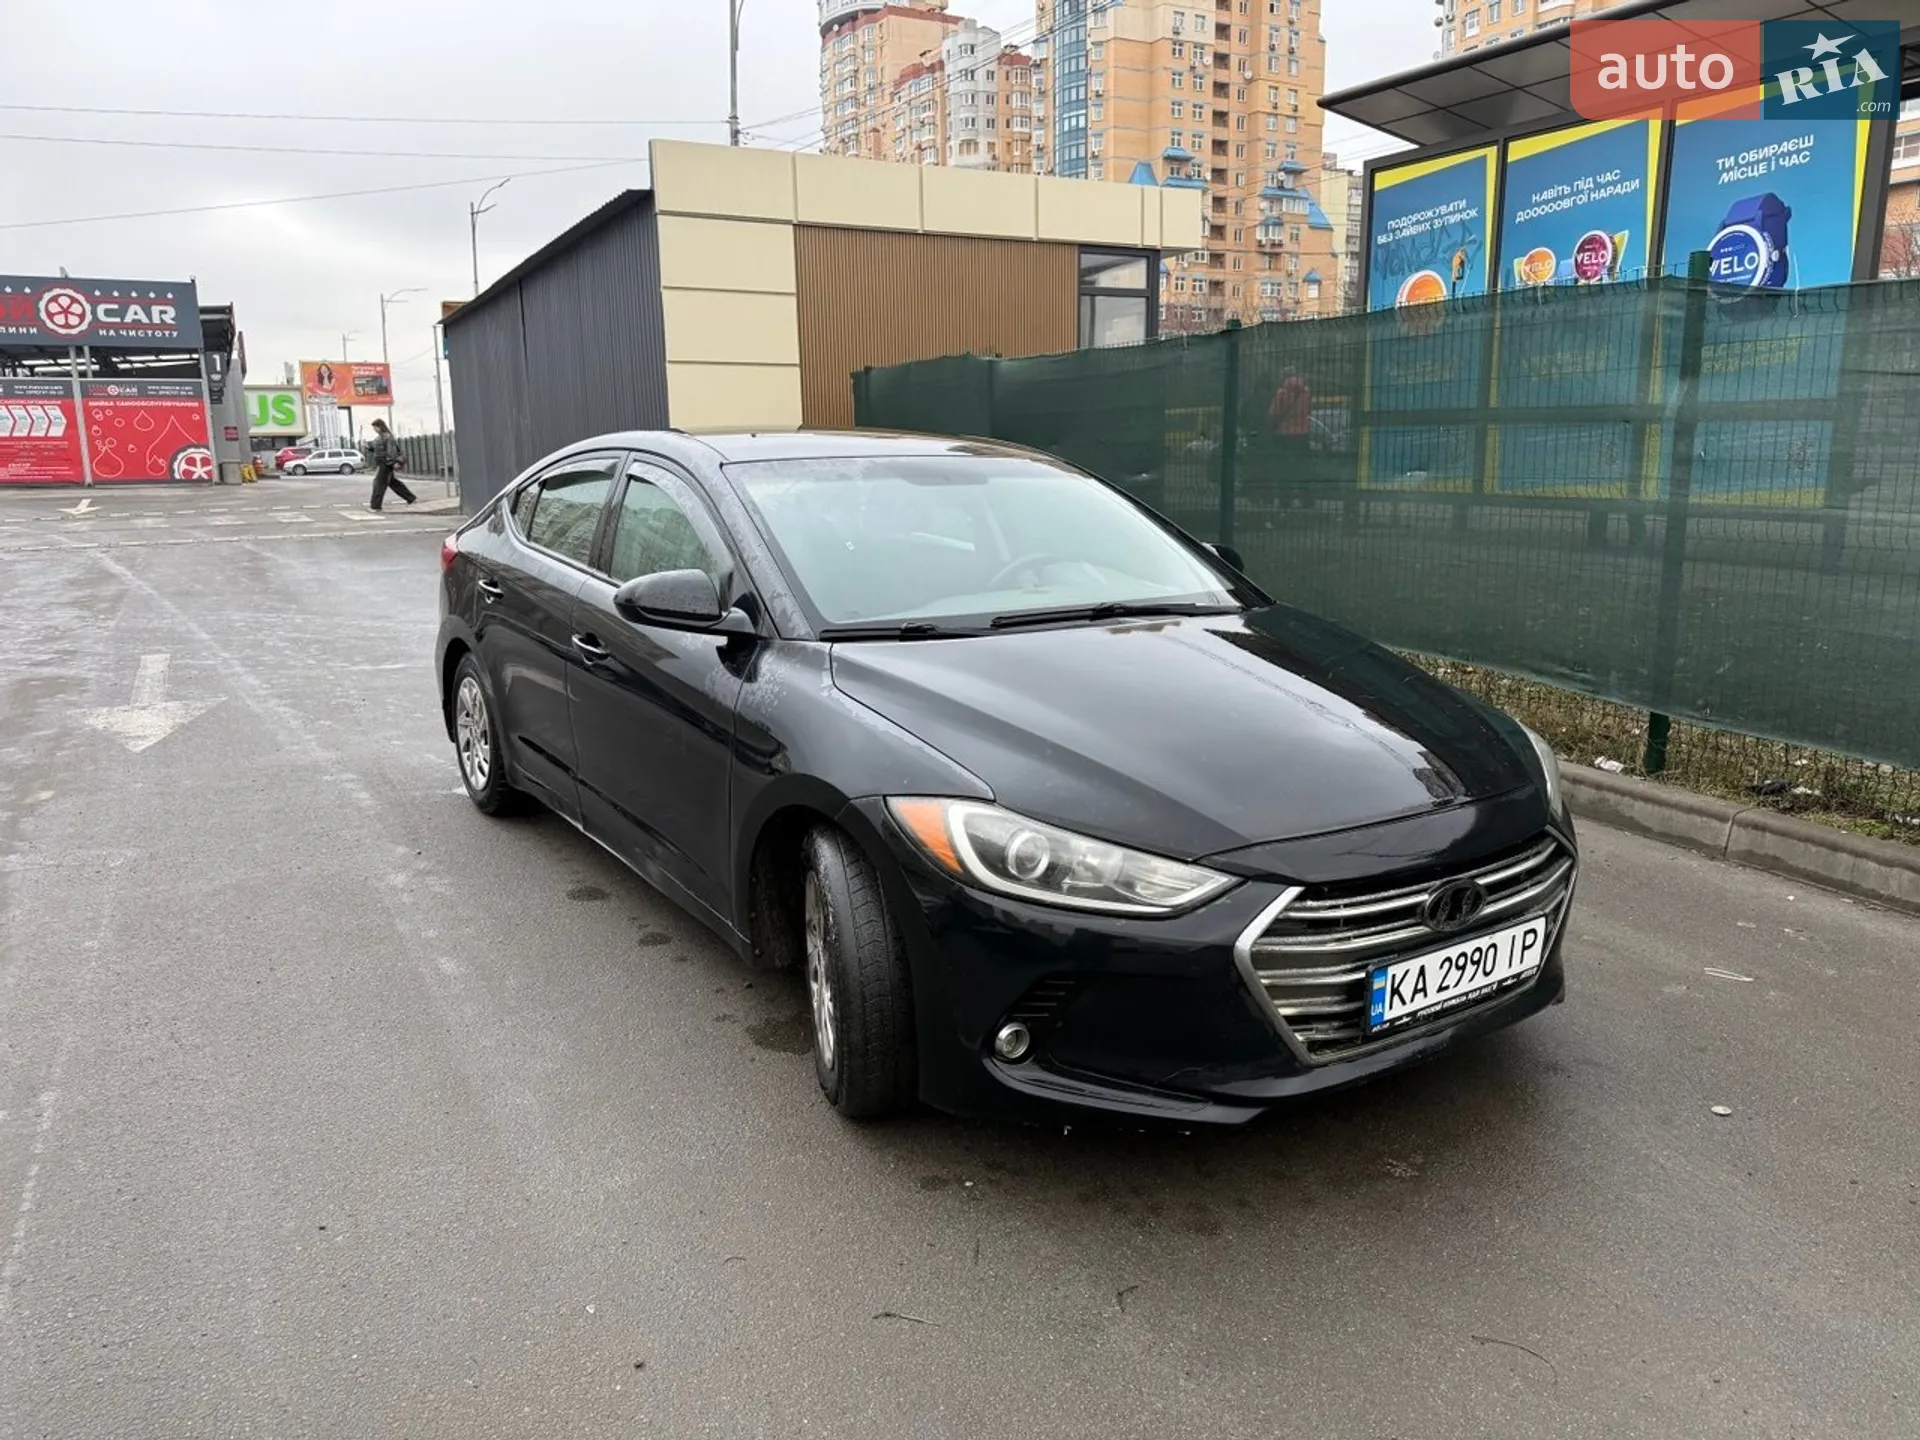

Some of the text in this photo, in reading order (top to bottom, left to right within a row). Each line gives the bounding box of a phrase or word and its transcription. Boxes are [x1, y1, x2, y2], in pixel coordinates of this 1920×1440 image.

[1716, 134, 1815, 171] ТИ ОБИРАЄШ
[1779, 151, 1811, 168] ЧАС
[1596, 169, 1621, 184] ЧАС
[1590, 179, 1640, 202] НАРАДИ
[1387, 198, 1467, 231] ПОДОРОЖУВАТИ
[1377, 207, 1479, 245] БЕЗ ЗАЙВИХ ЗУПИНОК
[1576, 250, 1608, 265] VELO
[1708, 251, 1759, 277] VELO
[96, 303, 177, 325] CAR
[99, 329, 116, 337] НА
[119, 329, 179, 338] ЧИСТОТУ
[1388, 963, 1429, 1012] KA
[1436, 942, 1499, 995] 2990
[1507, 927, 1539, 969] IP
[1370, 1003, 1384, 1016] UA
